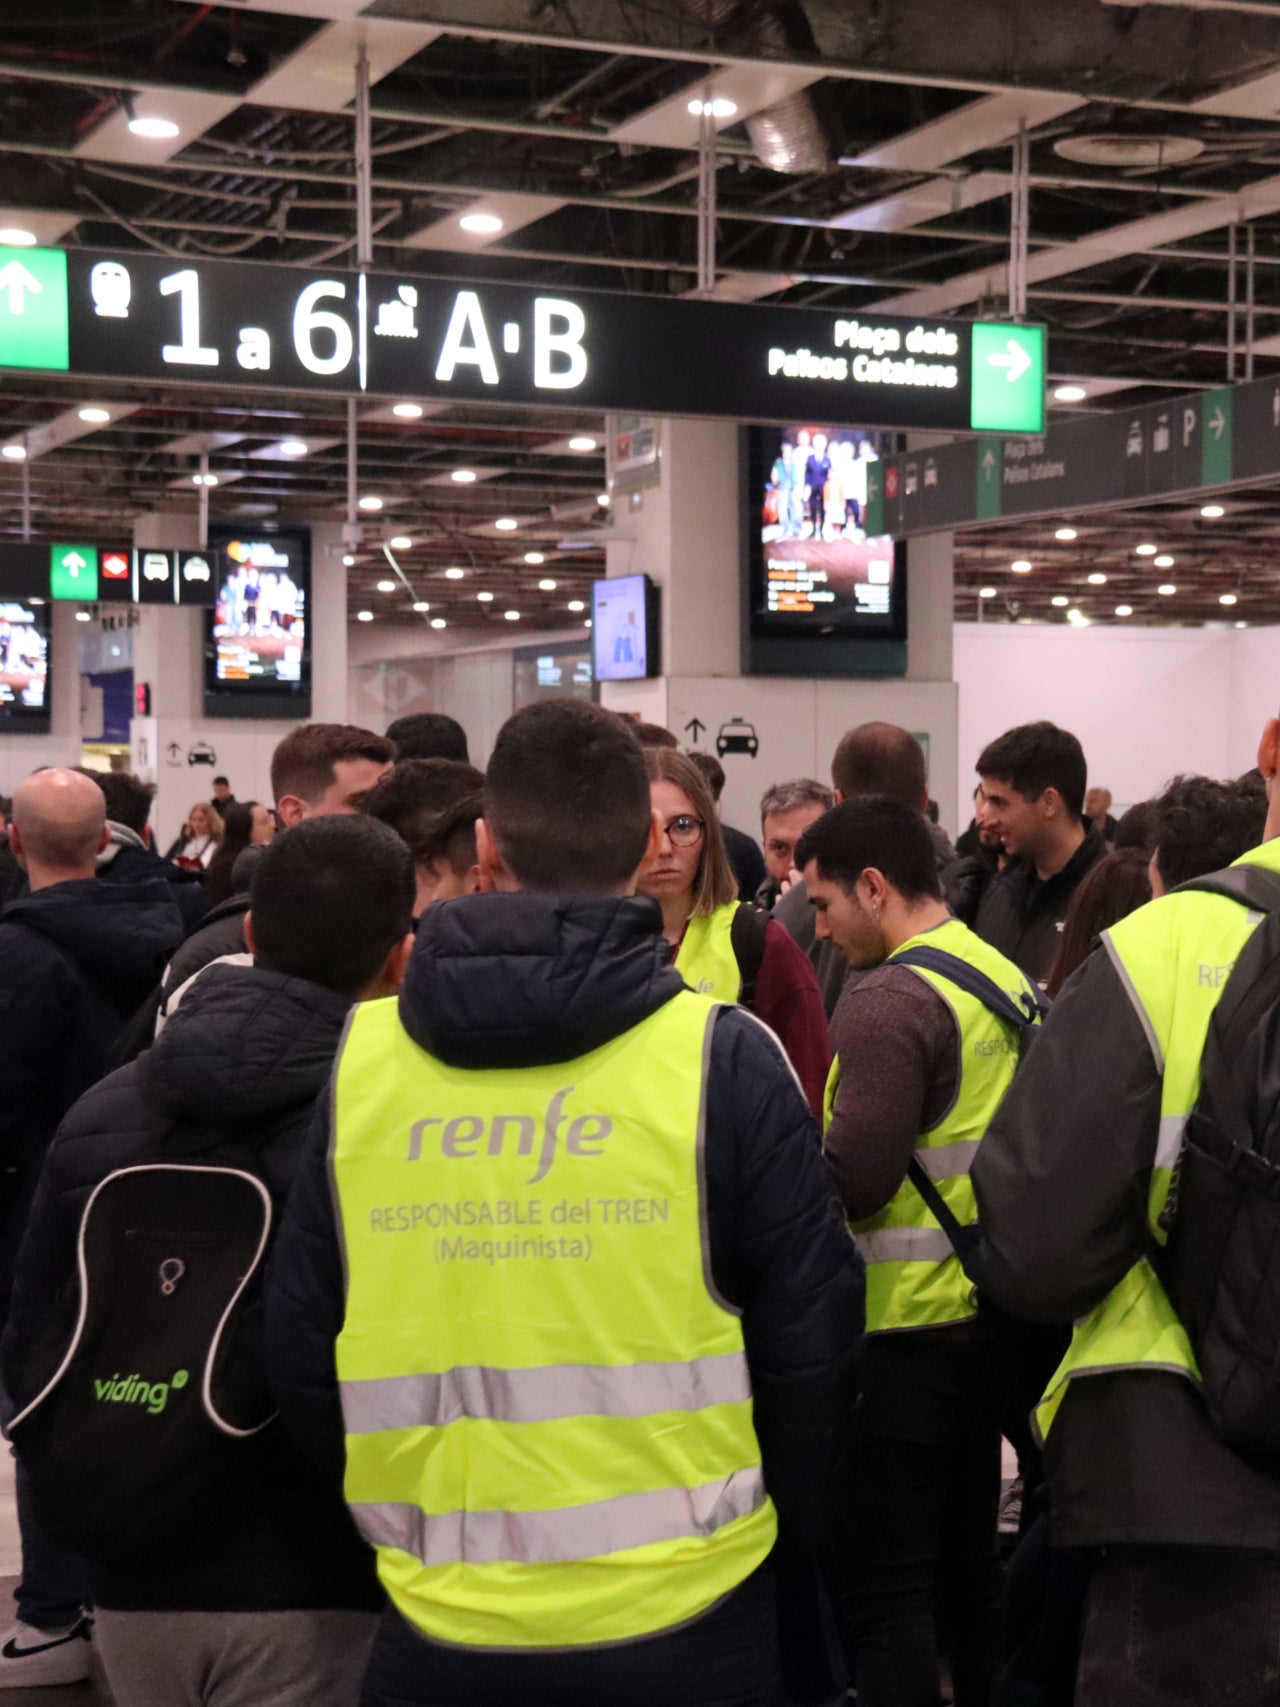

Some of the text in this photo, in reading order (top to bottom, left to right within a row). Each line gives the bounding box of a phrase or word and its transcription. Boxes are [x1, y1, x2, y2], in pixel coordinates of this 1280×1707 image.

[160, 270, 353, 375] 1 a 6
[834, 320, 958, 355] Plaça dels
[853, 354, 958, 388] Catalans
[408, 1086, 613, 1185] renfe
[370, 1198, 669, 1232] RESPONSABLE del TREN
[434, 1234, 593, 1265] (Maquinista)
[94, 1373, 170, 1414] viding
